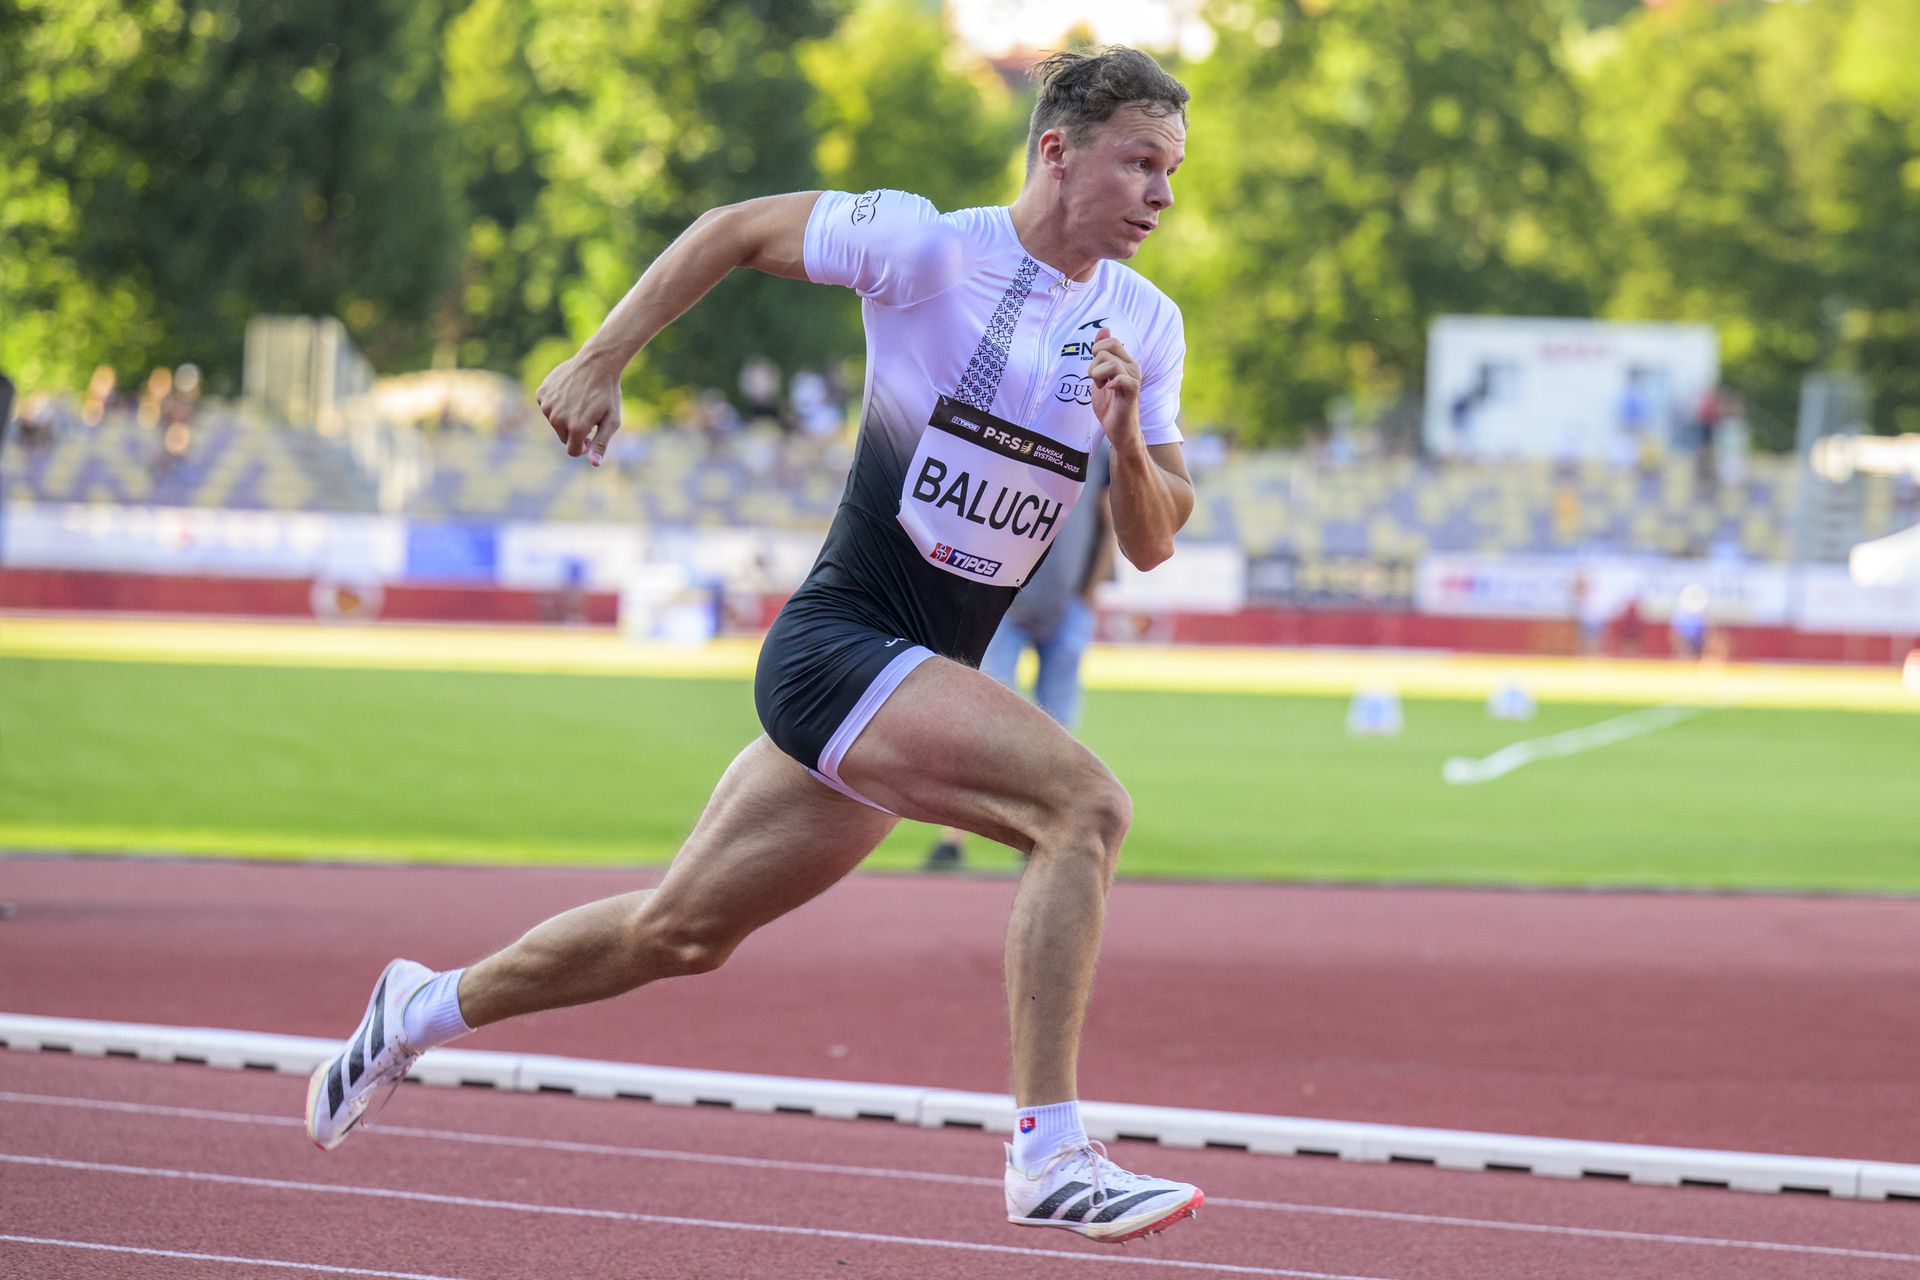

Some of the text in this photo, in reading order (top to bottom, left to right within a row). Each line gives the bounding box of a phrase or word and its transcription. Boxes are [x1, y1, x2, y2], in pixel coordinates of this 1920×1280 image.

[1059, 382, 1093, 397] DUK
[1033, 450, 1081, 473] BYSTRICA 2025
[1036, 444, 1064, 460] BANSKÁ
[912, 456, 1063, 542] BALUCH
[953, 551, 999, 576] TIPOS
